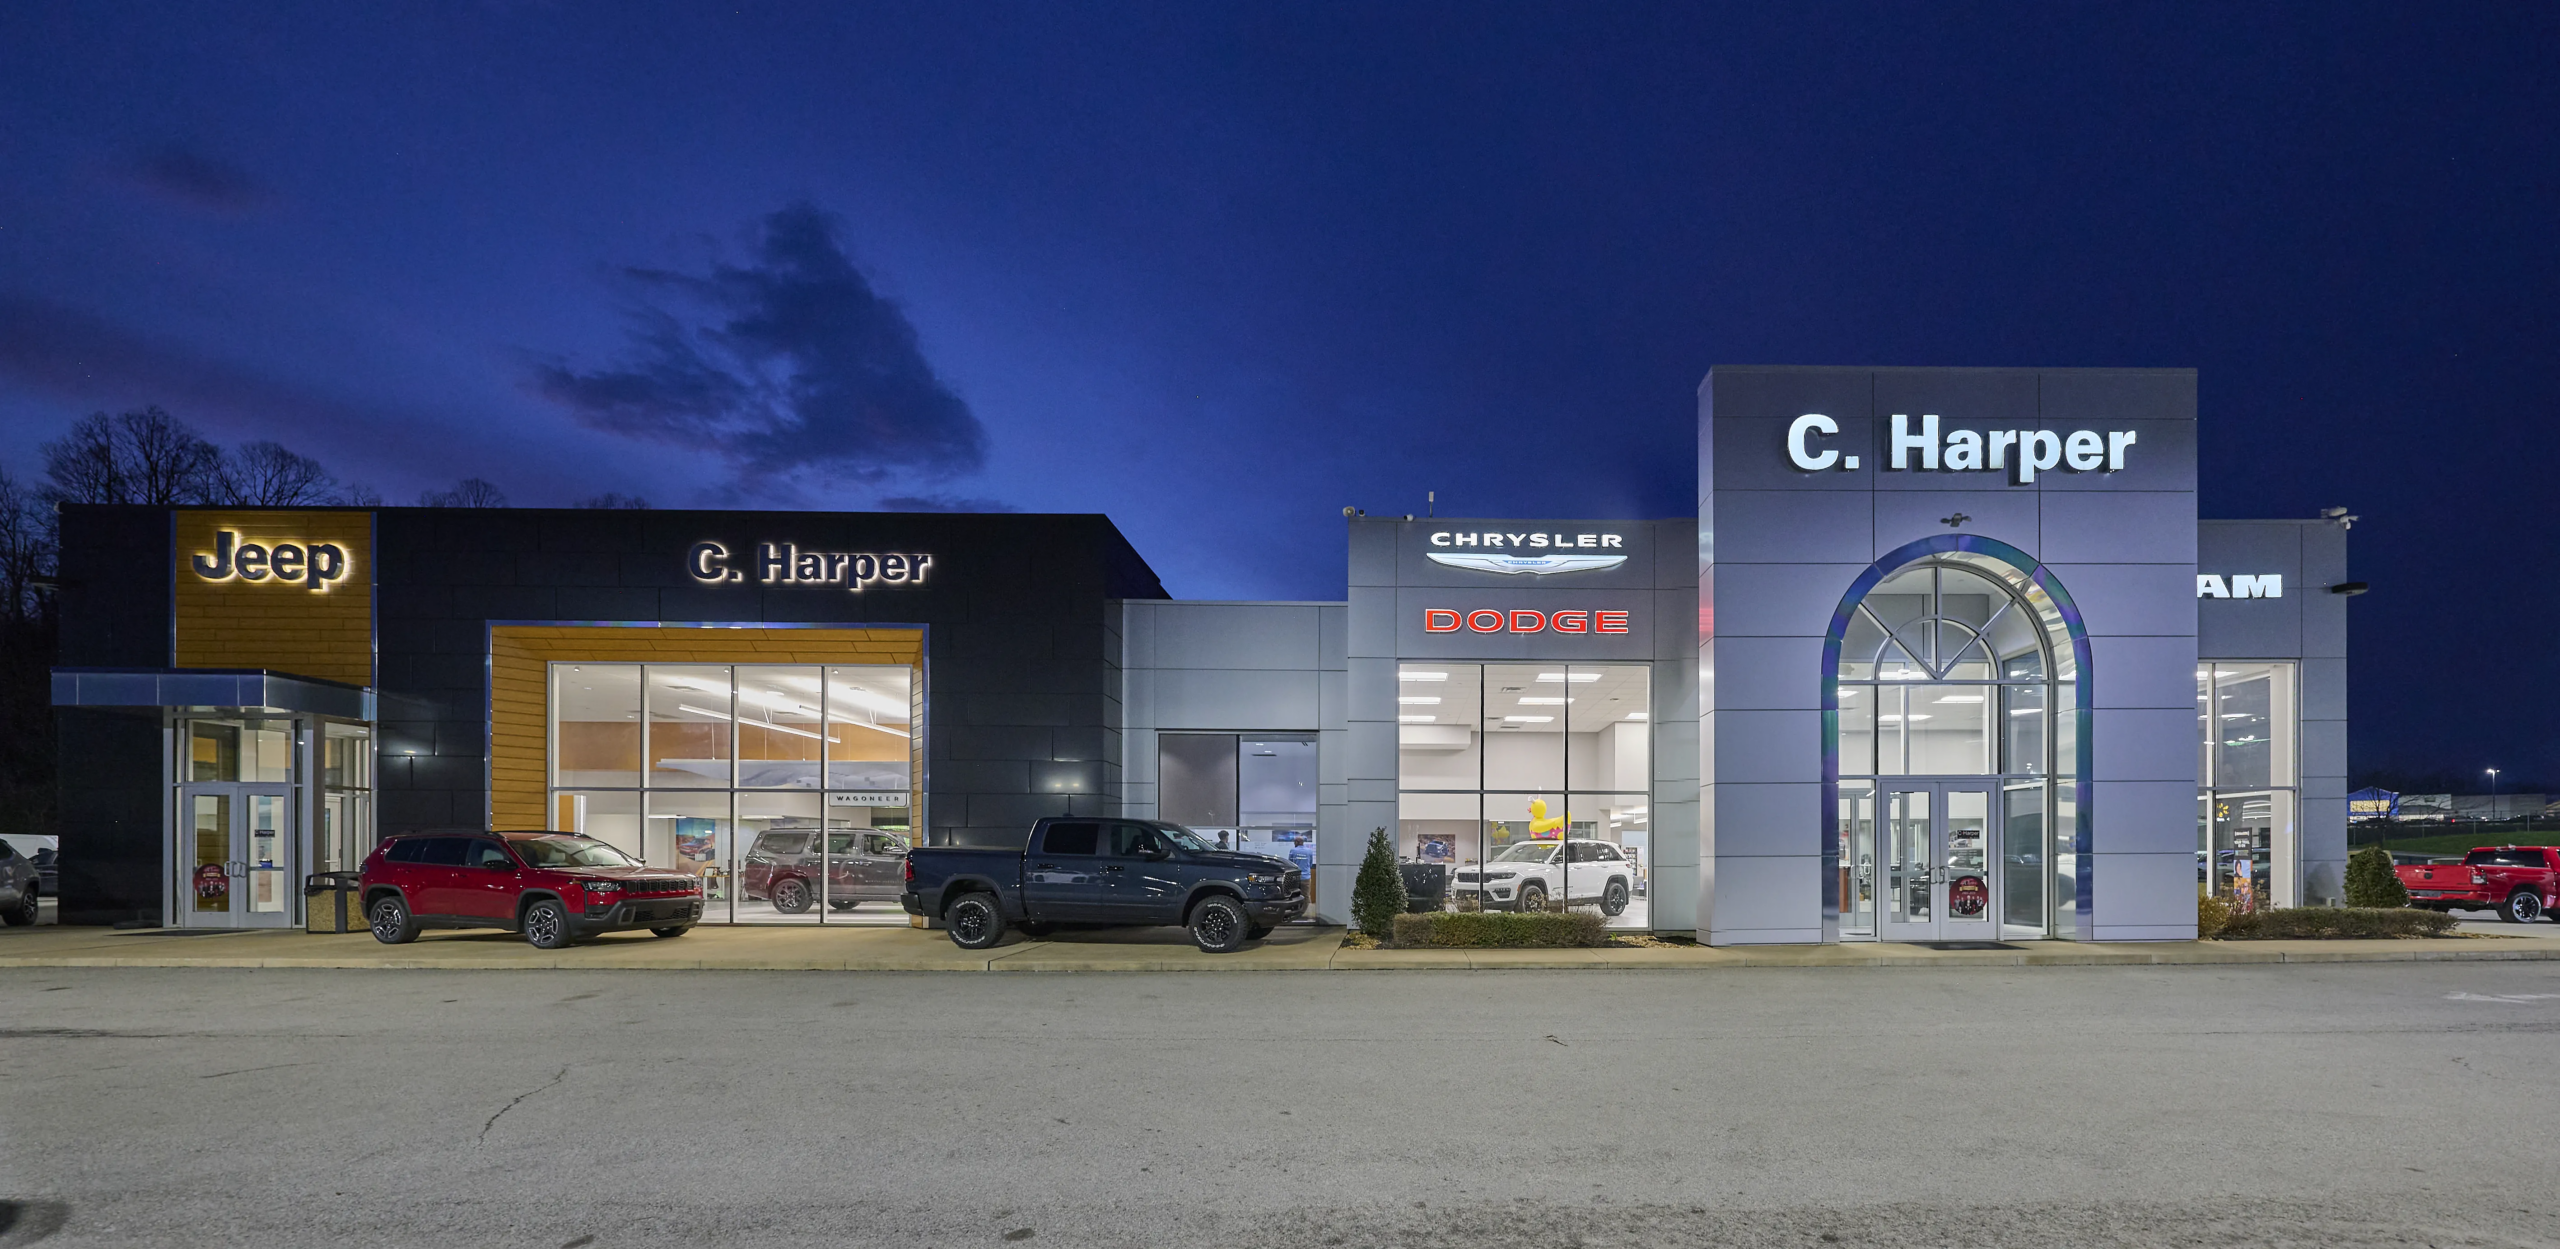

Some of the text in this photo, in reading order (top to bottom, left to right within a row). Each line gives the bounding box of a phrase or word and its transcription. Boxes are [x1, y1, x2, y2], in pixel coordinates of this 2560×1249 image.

[1787, 413, 2136, 483] C. Harper
[1430, 532, 1623, 548] CHRYSLER
[192, 531, 346, 591] Jeep
[688, 541, 932, 591] C. Harper
[2197, 574, 2283, 598] AM
[1425, 608, 1629, 634] DODGE
